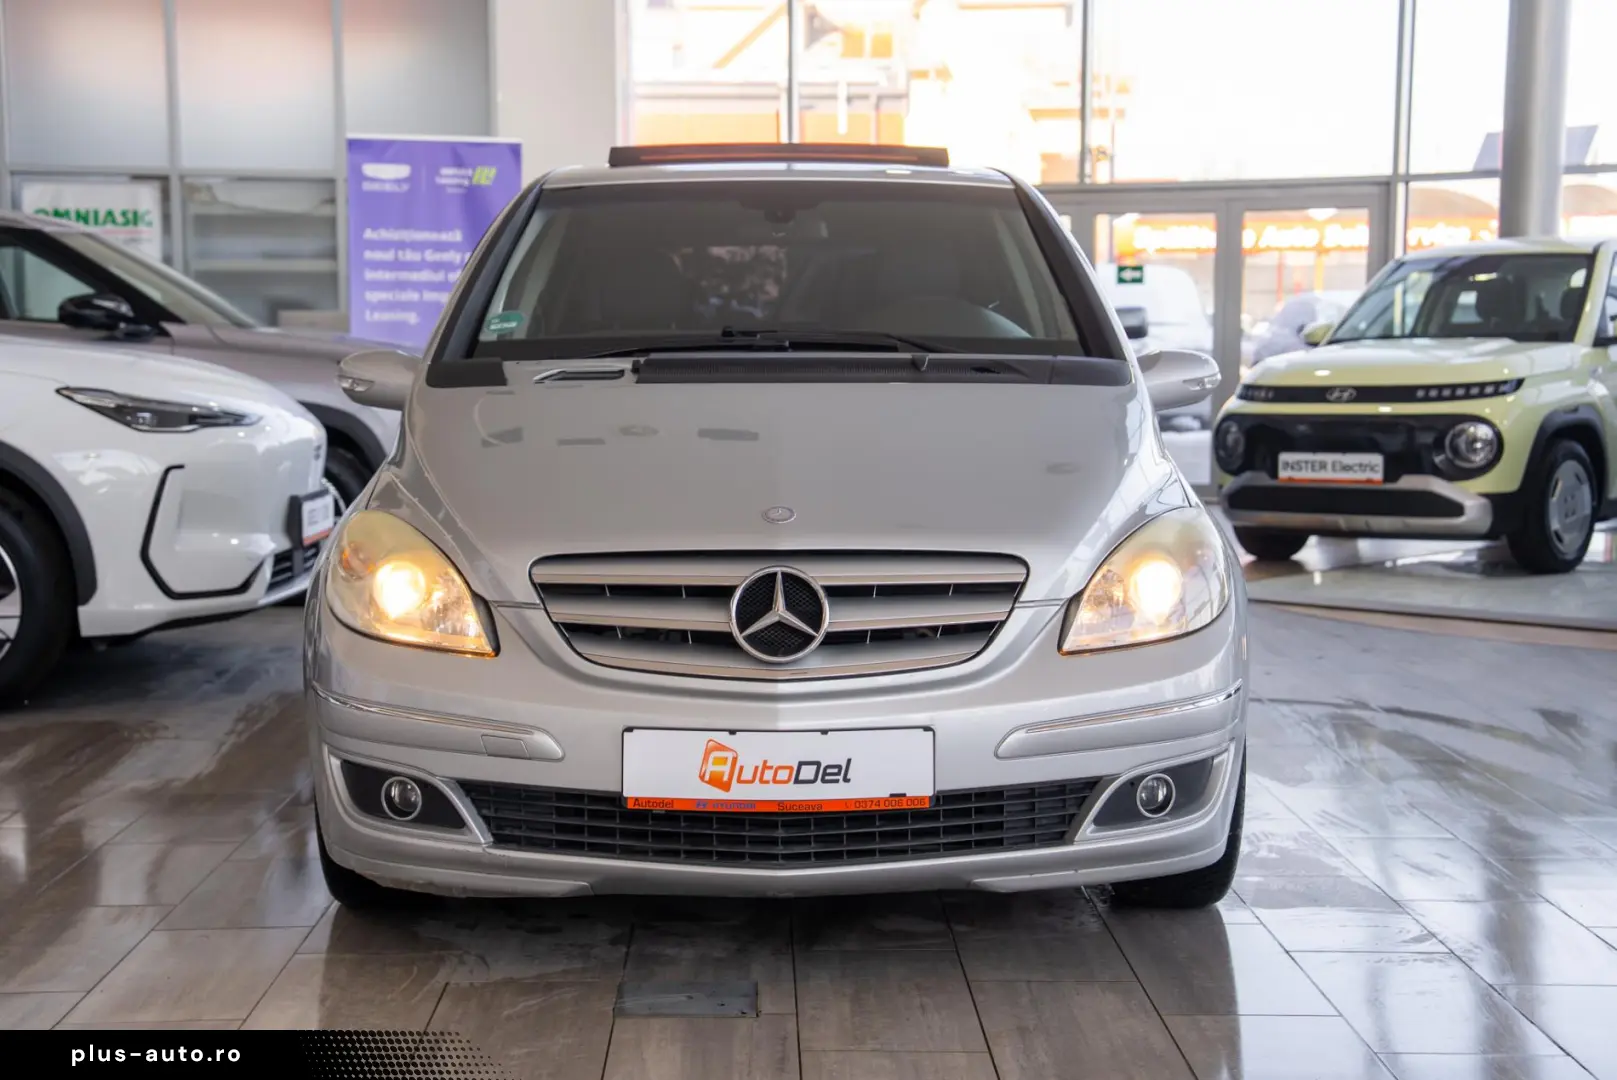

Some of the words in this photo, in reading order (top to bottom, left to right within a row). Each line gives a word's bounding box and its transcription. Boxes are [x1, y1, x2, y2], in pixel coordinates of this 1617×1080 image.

[424, 249, 462, 266] Geely
[1281, 459, 1328, 472] INSTER
[1331, 460, 1380, 473] Electric
[701, 744, 852, 788] AutoDel
[632, 798, 674, 810] Autodel
[778, 802, 823, 812] Suceava
[854, 799, 881, 809] 0374
[883, 799, 903, 808] 006
[906, 798, 925, 807] 006
